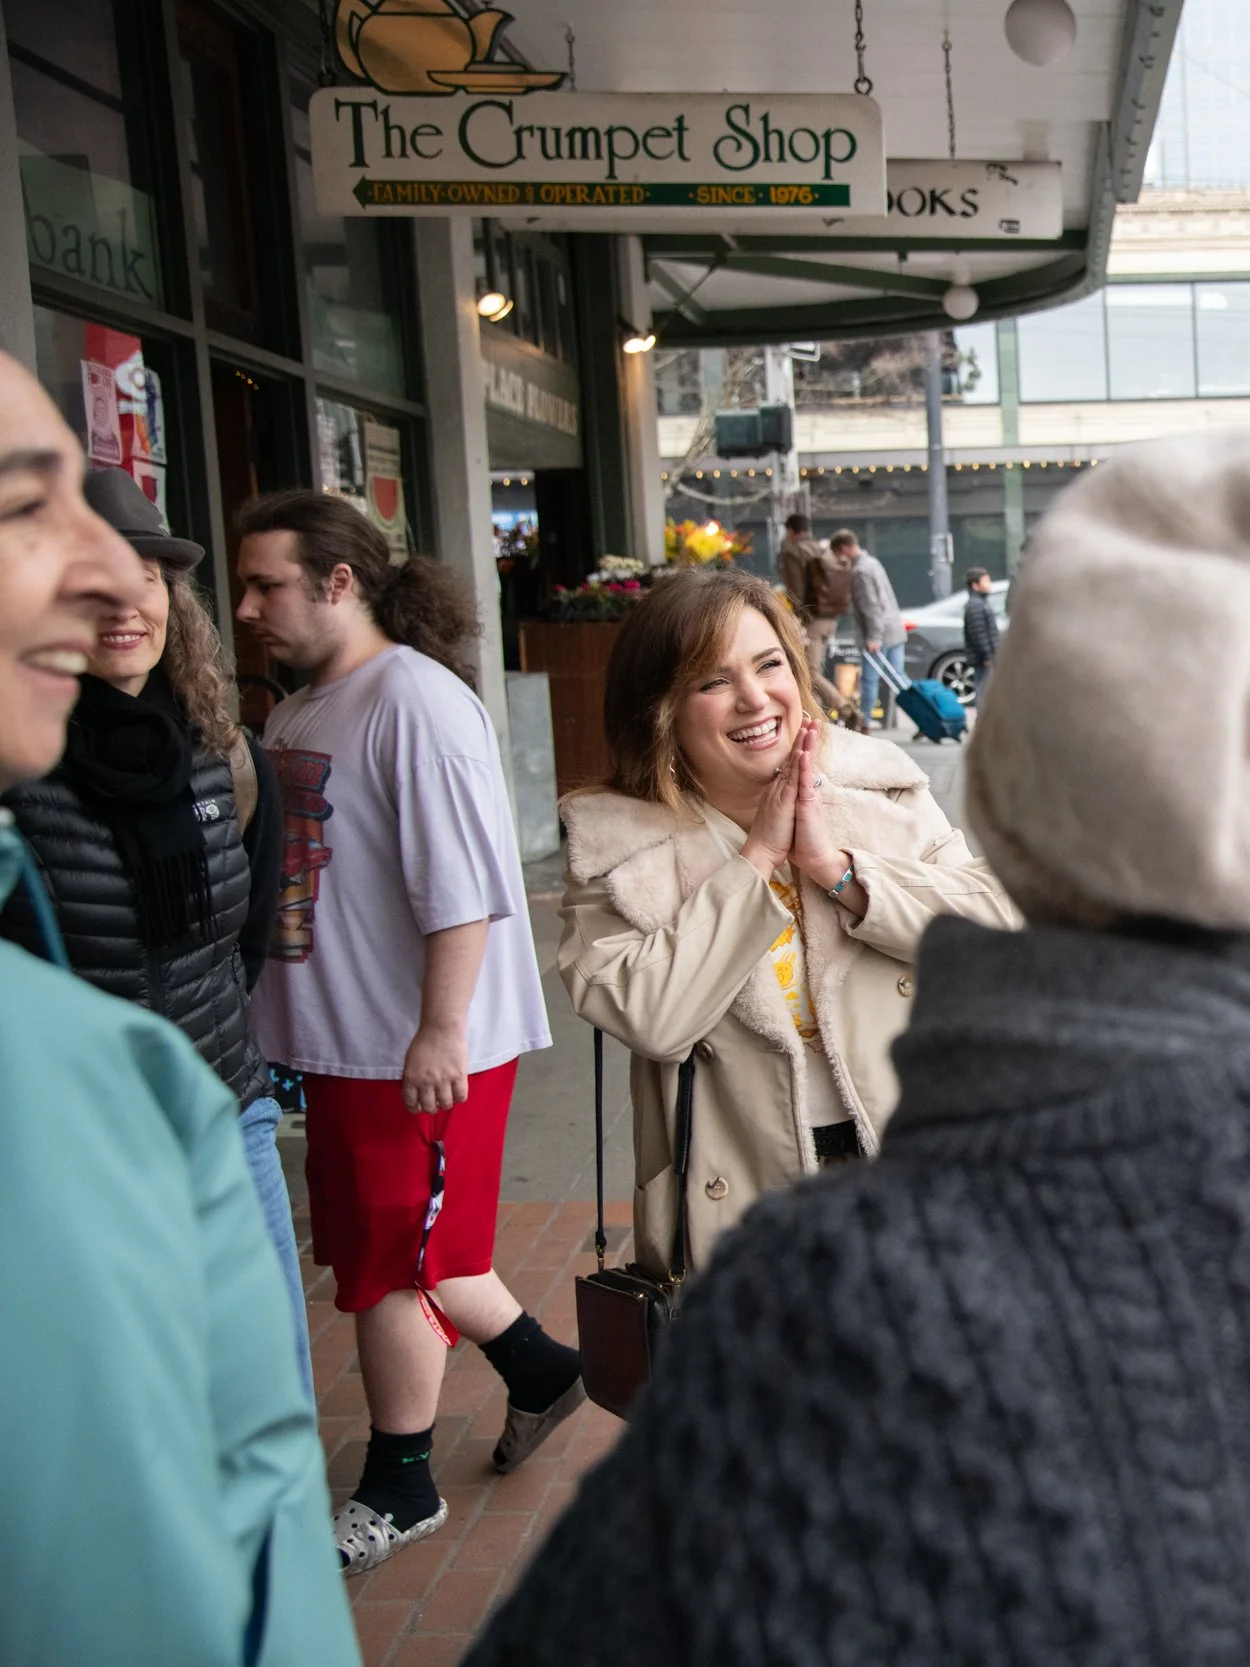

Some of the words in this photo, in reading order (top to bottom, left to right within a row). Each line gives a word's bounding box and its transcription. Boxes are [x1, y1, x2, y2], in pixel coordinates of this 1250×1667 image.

[334, 98, 443, 168] The
[458, 99, 691, 180] Crumpet
[713, 104, 857, 180] Shop
[371, 184, 441, 201] FAMILY
[447, 184, 519, 202] OWNED
[540, 184, 643, 204] OPERATED
[697, 186, 755, 204] SINCE
[769, 186, 812, 205] 1976
[888, 186, 978, 218] OKS
